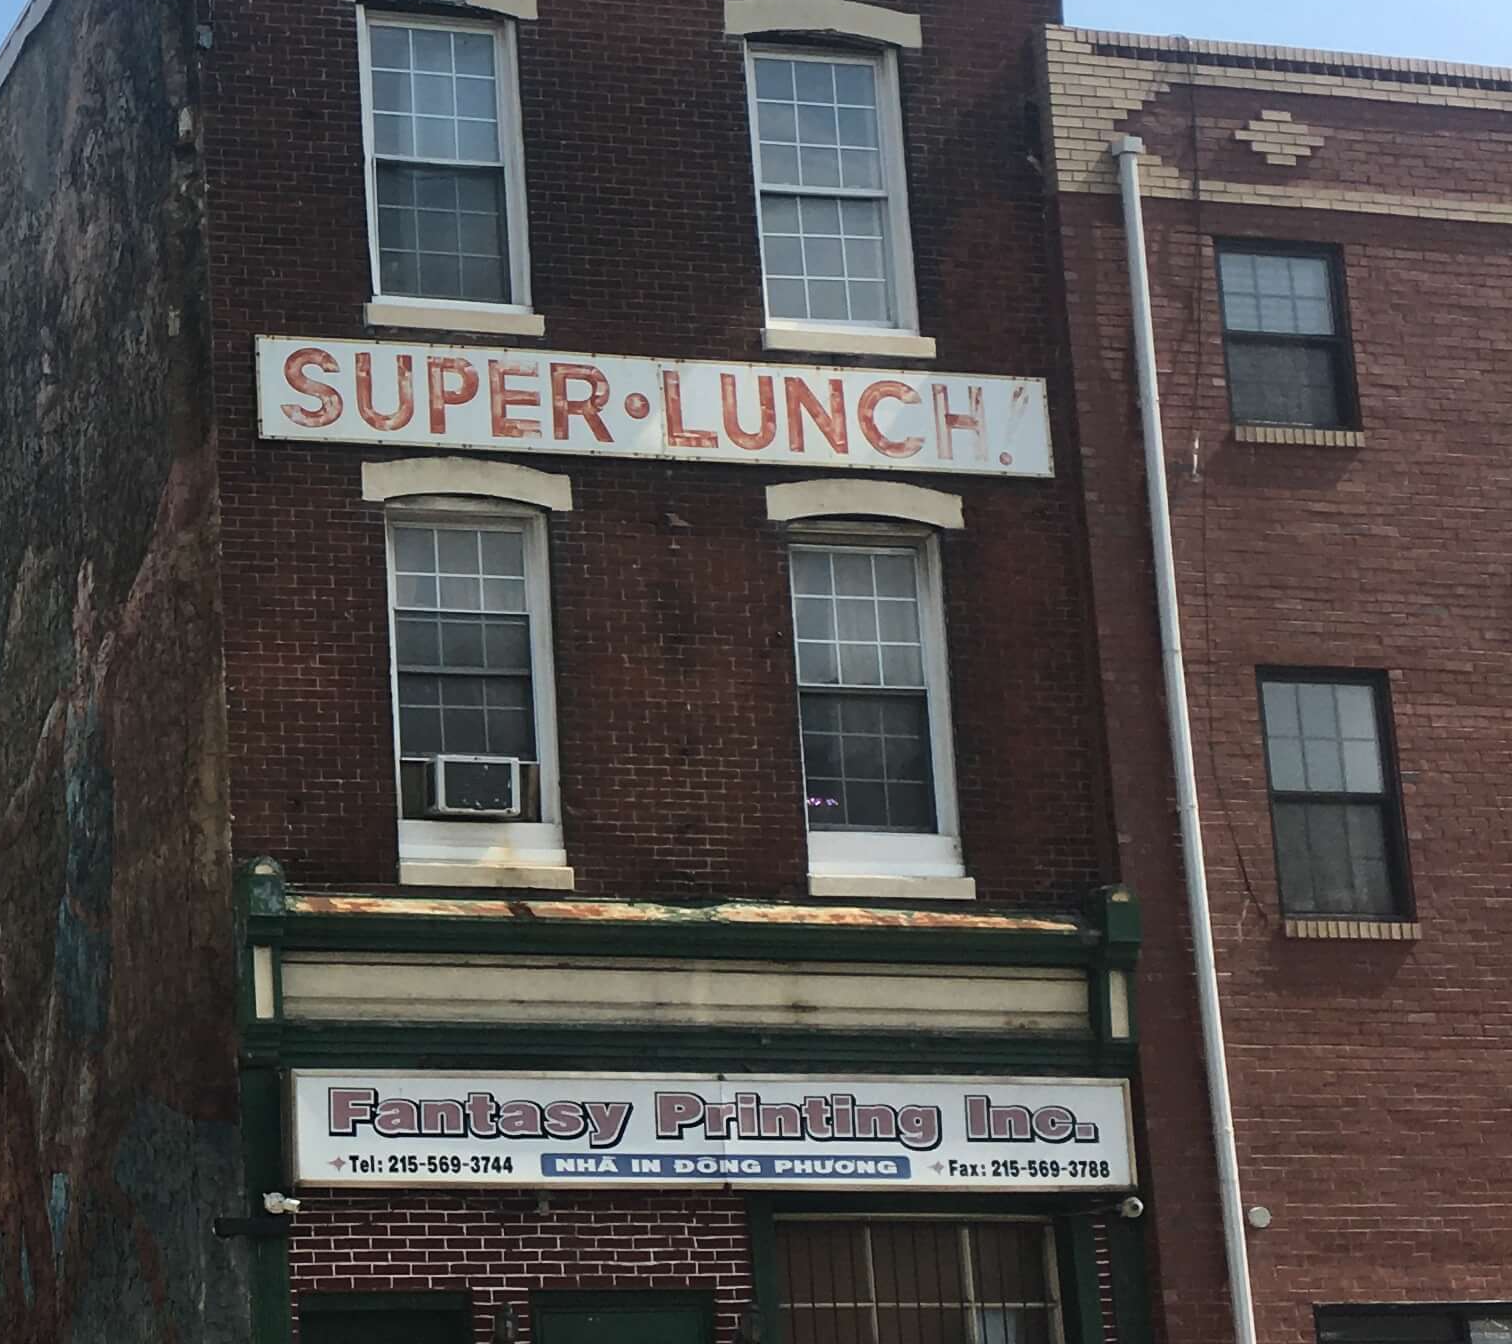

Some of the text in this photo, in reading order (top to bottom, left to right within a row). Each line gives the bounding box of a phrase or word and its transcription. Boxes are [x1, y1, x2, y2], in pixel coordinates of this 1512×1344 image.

[281, 346, 615, 443] SUPER
[328, 1087, 1100, 1152] Fantasy Printing Inc.
[348, 1155, 514, 1175] Tel: 215-569-3744
[631, 1158, 661, 1173] IN
[949, 1159, 1110, 1179] Fax: 215-569-3788
